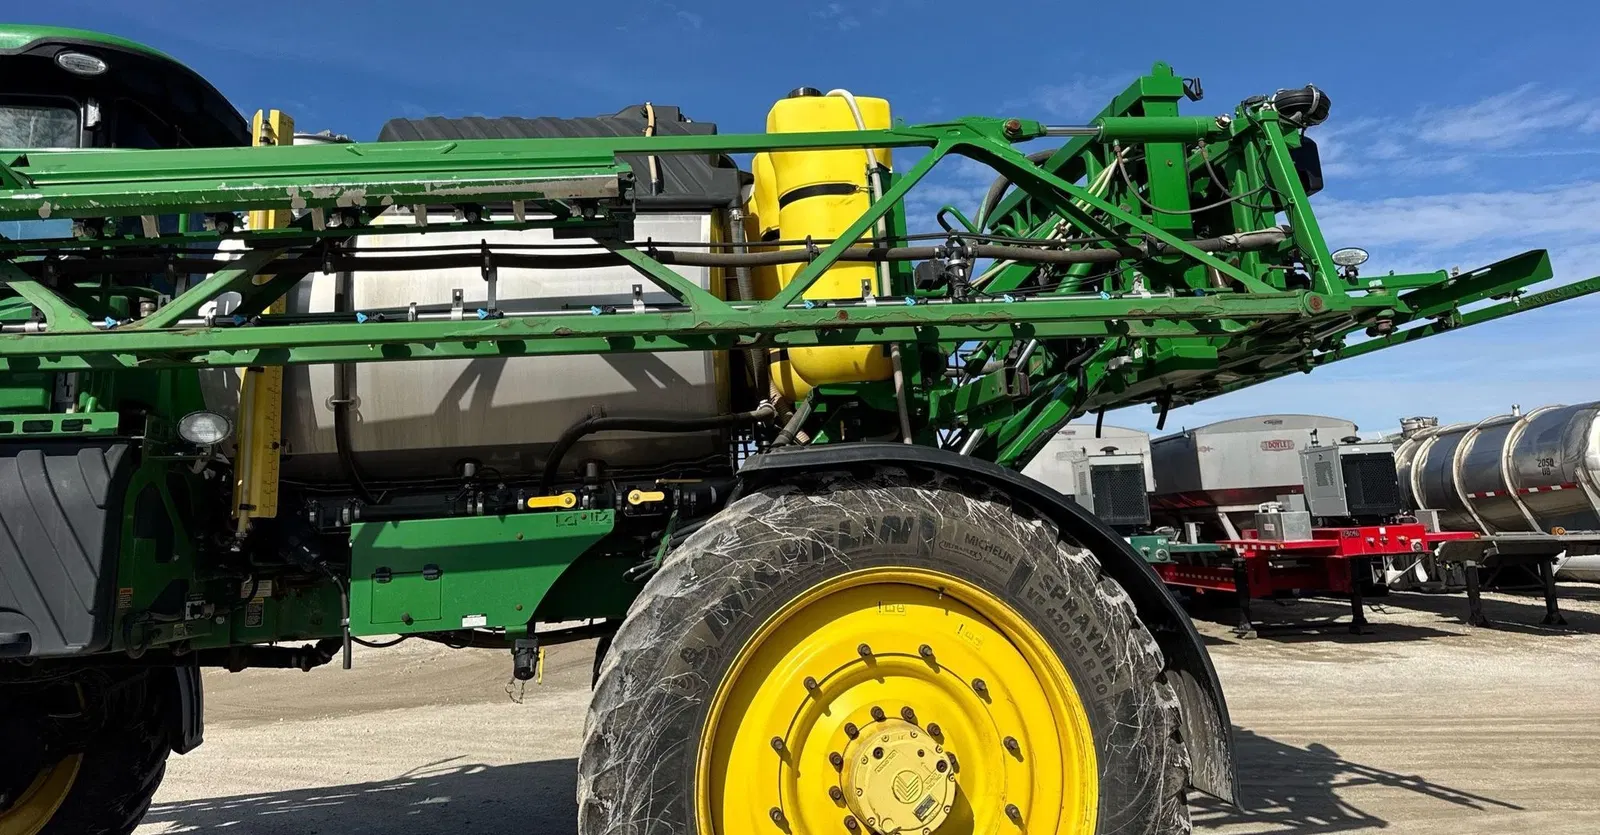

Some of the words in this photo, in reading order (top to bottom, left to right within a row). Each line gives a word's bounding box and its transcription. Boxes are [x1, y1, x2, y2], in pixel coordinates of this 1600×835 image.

[964, 533, 1016, 564] MICHELIN
[1026, 586, 1047, 607] VF
[1044, 606, 1089, 658] 420/95
[1082, 657, 1098, 673] R
[1091, 673, 1109, 696] 50
